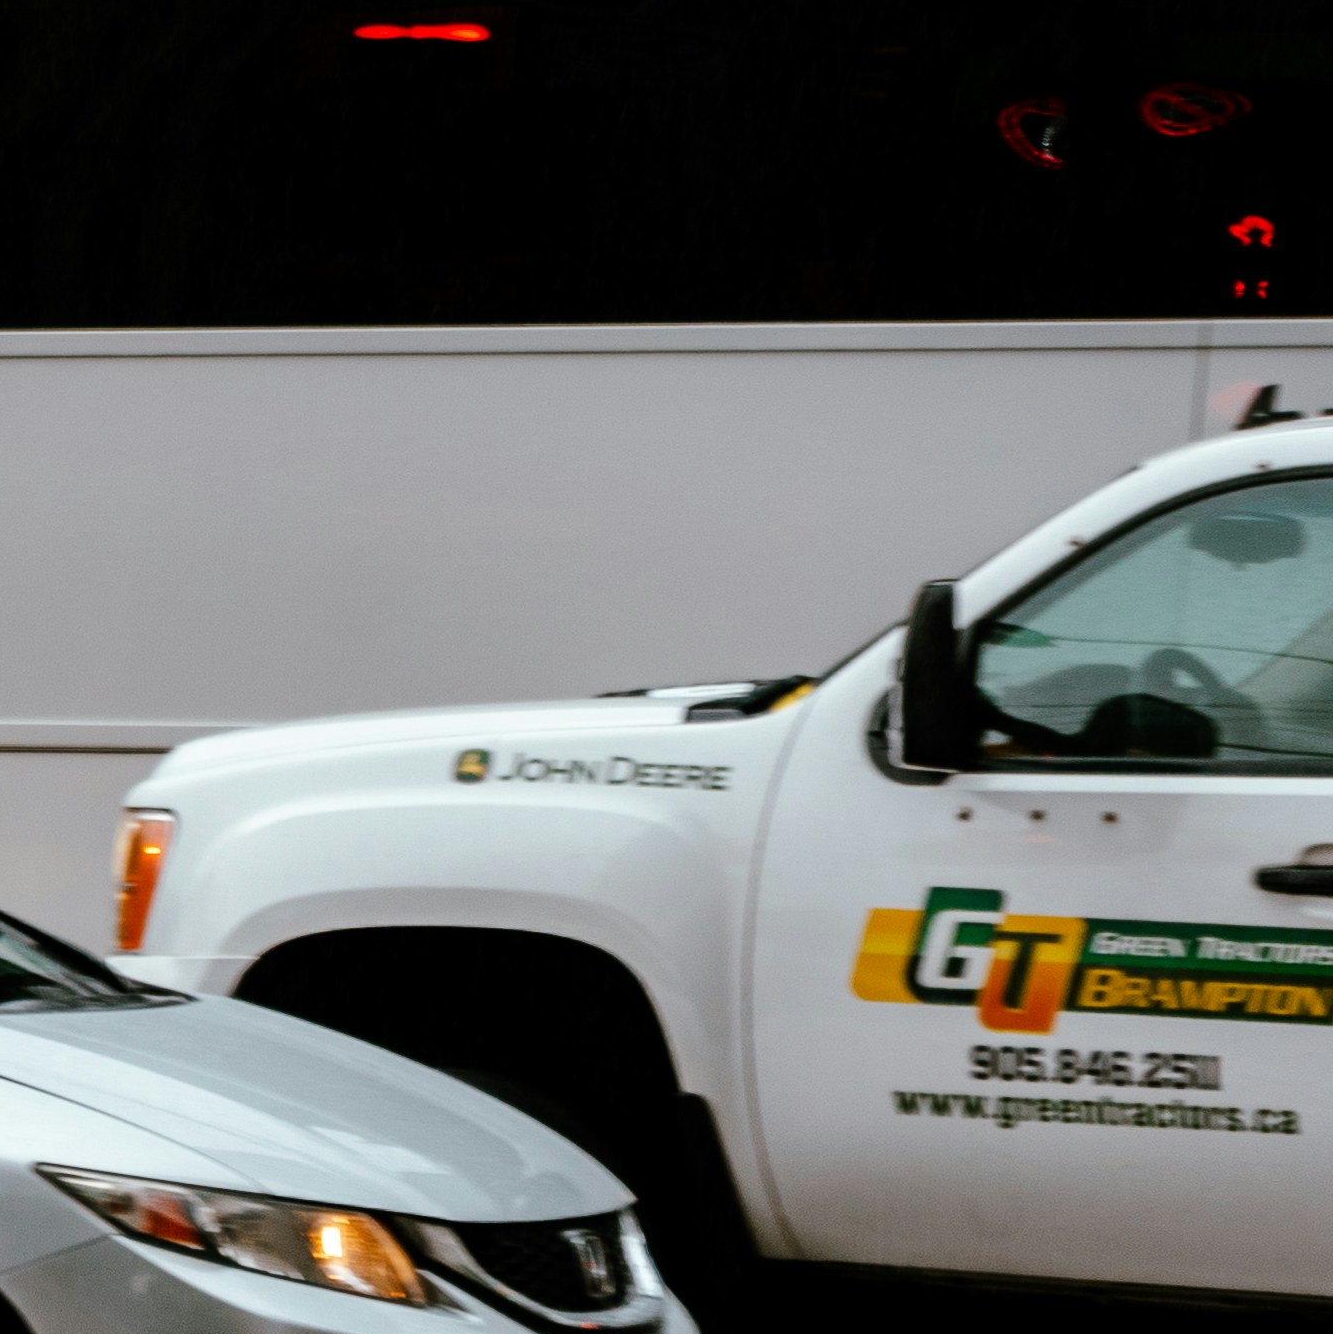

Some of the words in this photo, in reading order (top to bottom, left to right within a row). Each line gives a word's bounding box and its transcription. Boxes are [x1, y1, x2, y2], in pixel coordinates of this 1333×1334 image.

[496, 752, 601, 784] JOHN
[607, 755, 732, 791] DEERE
[1089, 931, 1190, 958] GREEN
[1195, 936, 1333, 966] TRACTORS
[1077, 968, 1333, 1017] BRAMPTON
[969, 1044, 1222, 1091] 905.846.2511
[893, 1090, 1301, 1135] www.greentractors.ca
